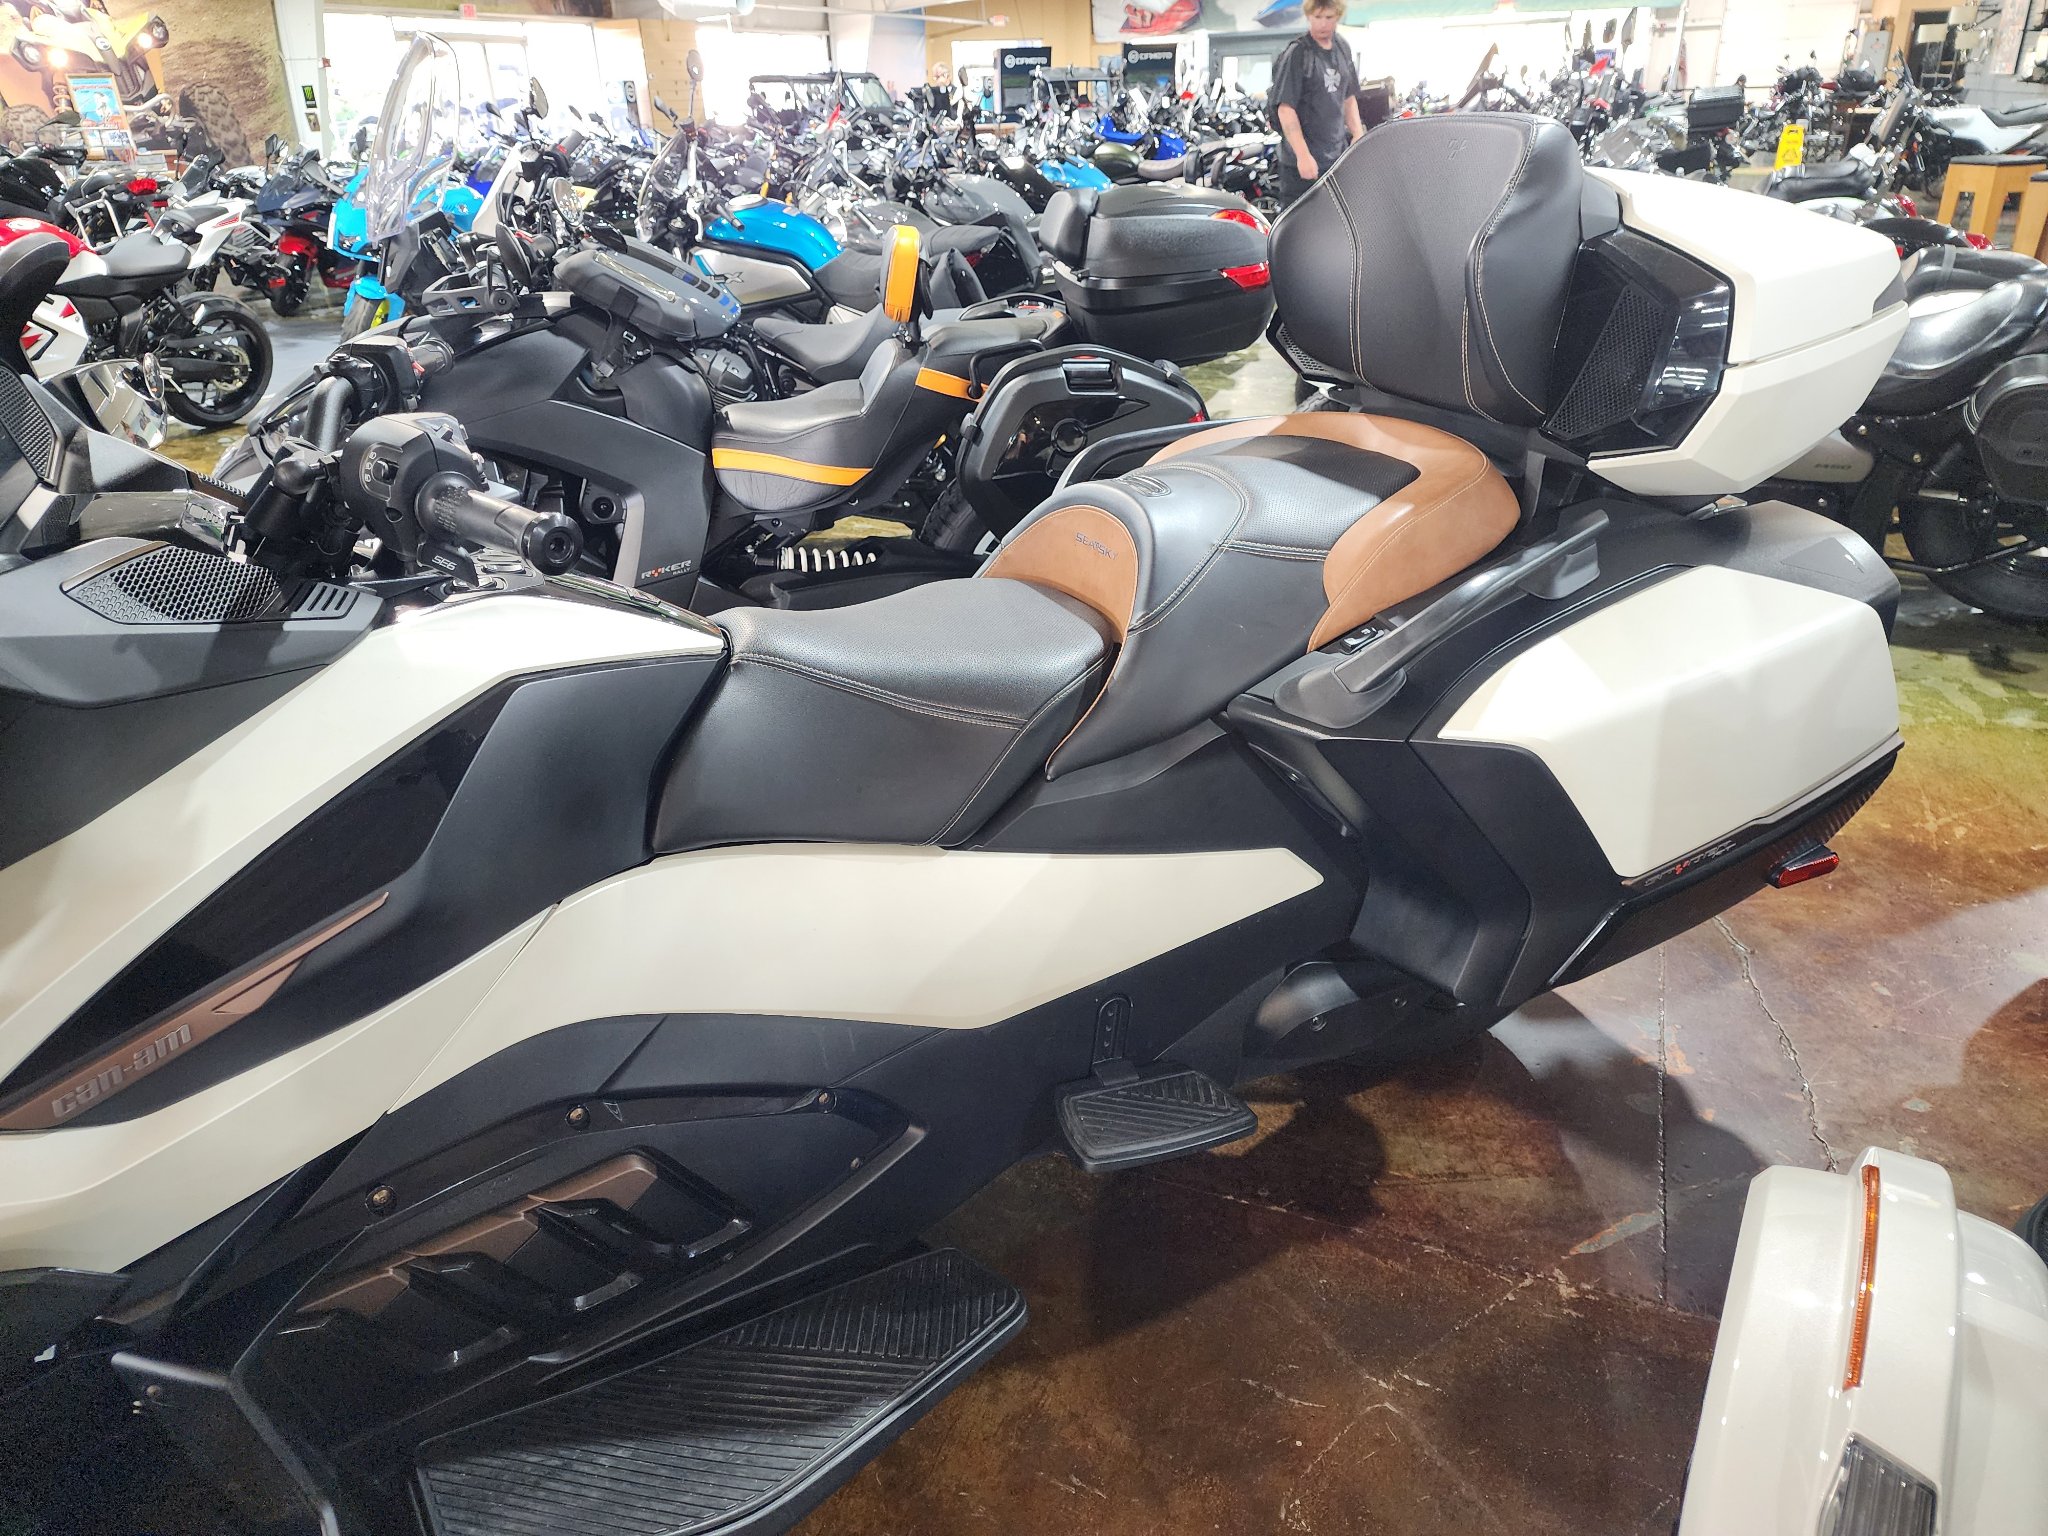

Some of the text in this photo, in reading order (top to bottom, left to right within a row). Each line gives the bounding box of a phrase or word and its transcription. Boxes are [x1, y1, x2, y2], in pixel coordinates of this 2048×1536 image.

[431, 555, 457, 571] SE6
[641, 559, 692, 579] RYKER
[672, 567, 691, 576] RALLY
[51, 1023, 193, 1118] can-am
